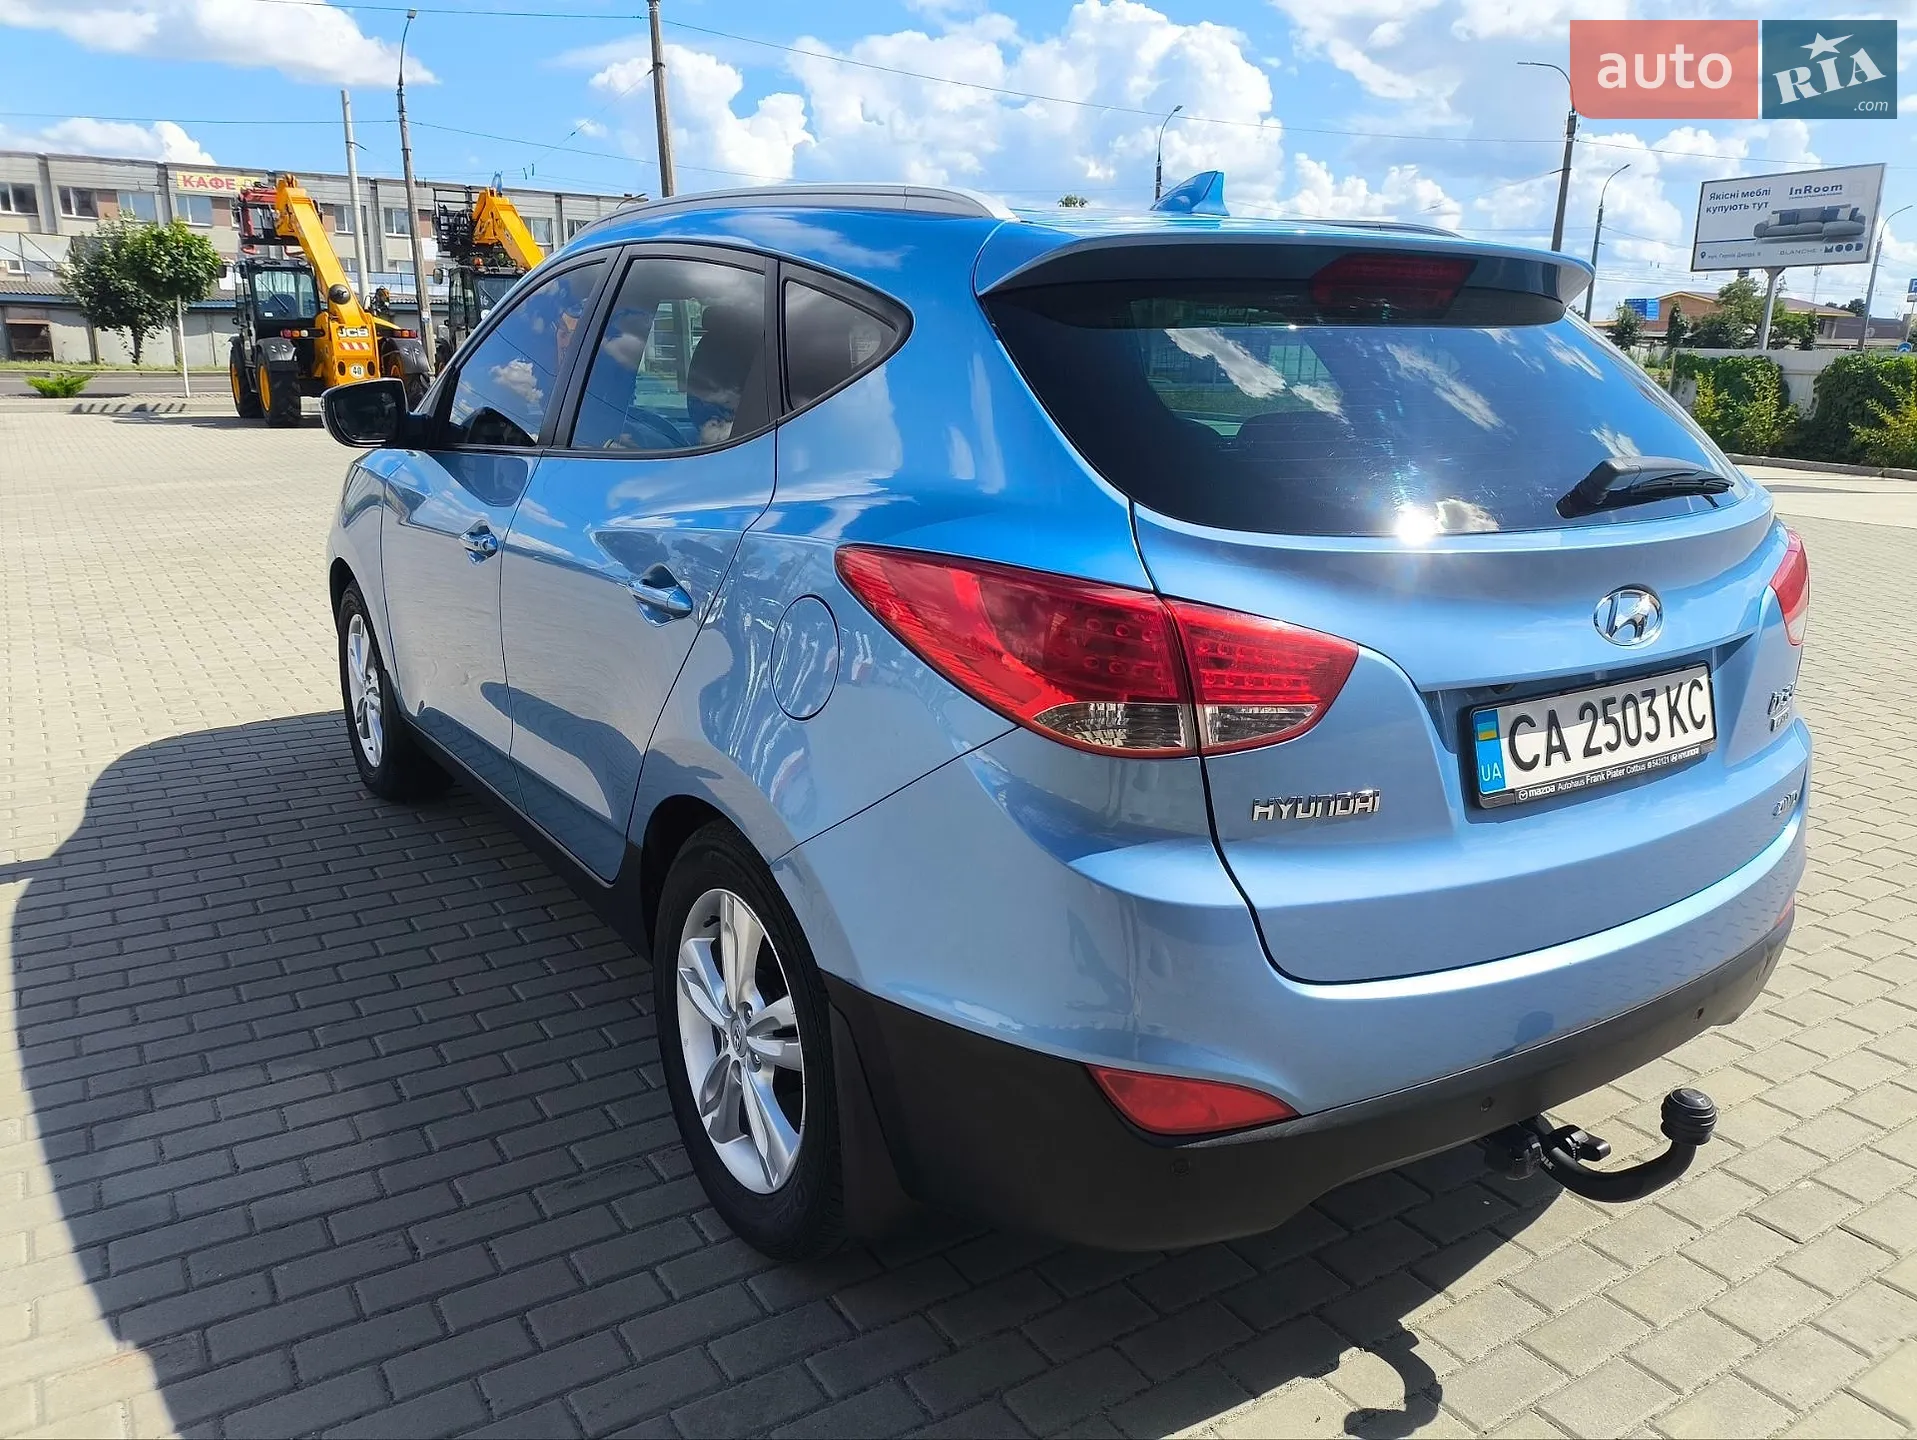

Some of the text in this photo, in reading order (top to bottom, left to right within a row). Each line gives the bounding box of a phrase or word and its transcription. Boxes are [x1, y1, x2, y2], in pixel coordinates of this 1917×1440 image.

[182, 174, 236, 190] КАФЕ
[1709, 187, 1771, 201] Якісні меблі
[1789, 184, 1843, 196] InRoom
[1706, 202, 1769, 214] купують тут
[1824, 242, 1864, 254] MOOD
[338, 327, 369, 338] JCB
[352, 366, 362, 375] 40
[1508, 678, 1707, 772] CA 2503 KC
[1481, 764, 1502, 783] UA
[1557, 779, 1586, 792] Autohaus
[1586, 772, 1606, 785] Frank
[1253, 789, 1381, 821] HYUNDAI
